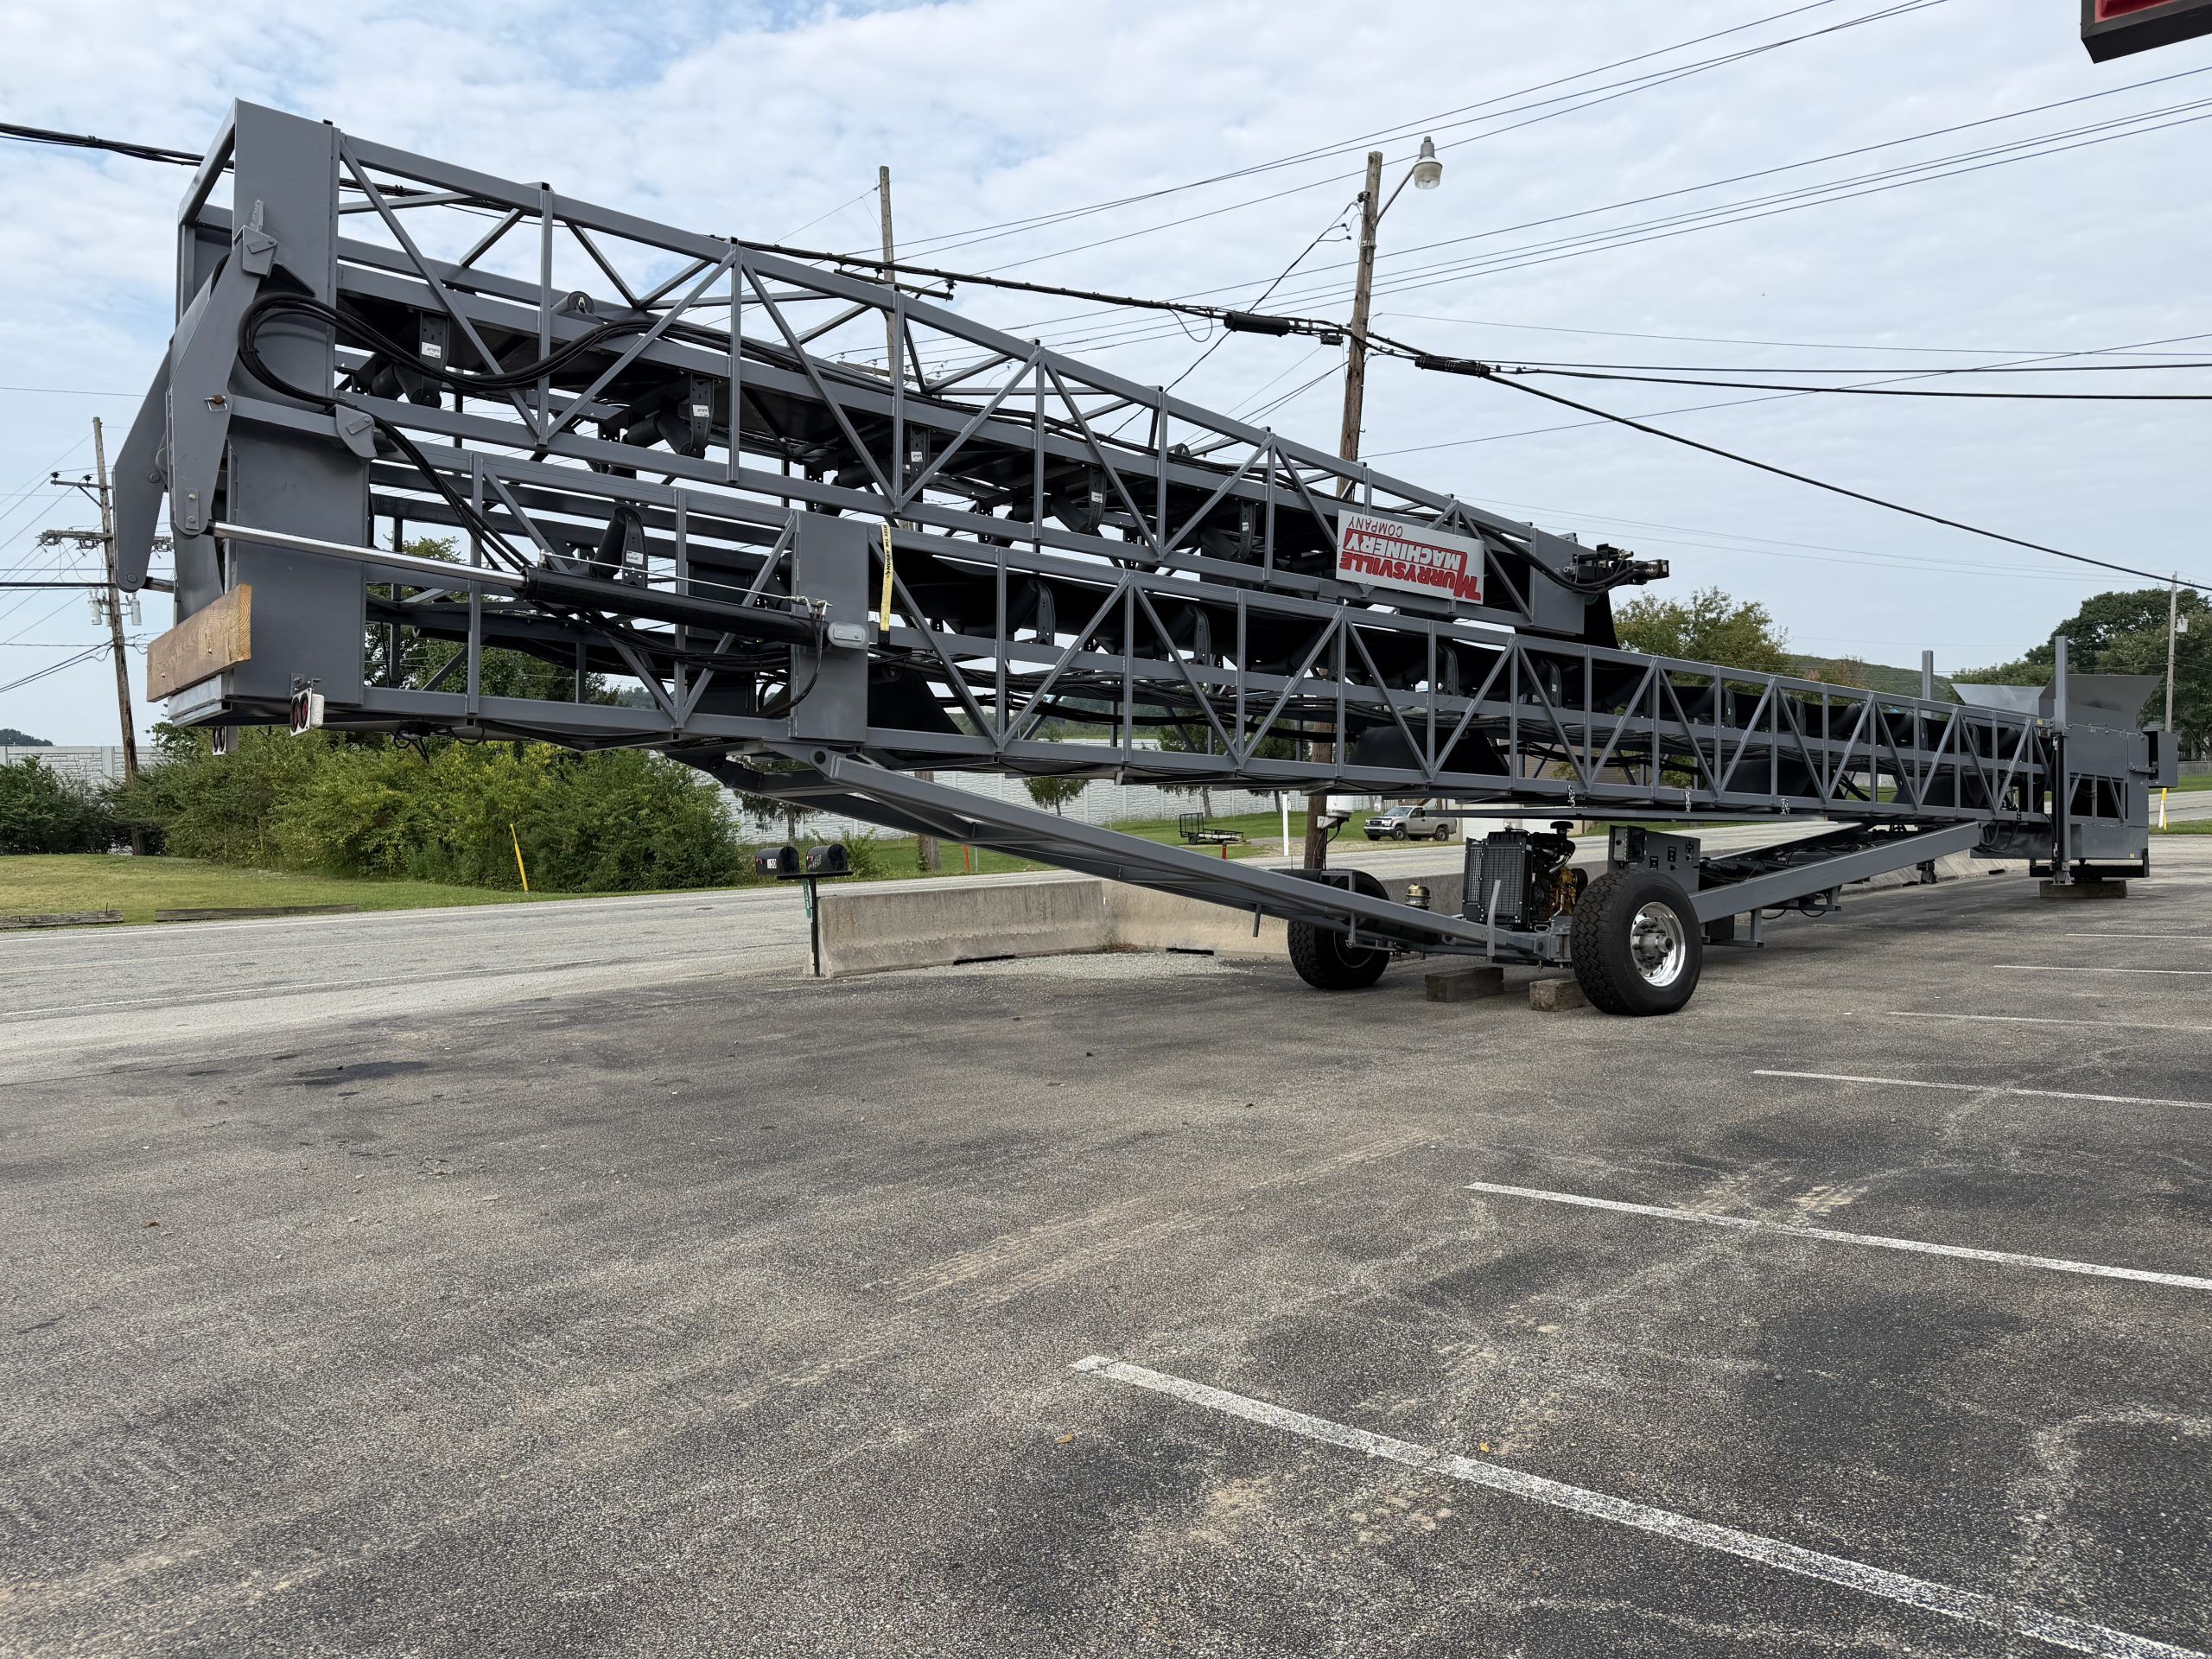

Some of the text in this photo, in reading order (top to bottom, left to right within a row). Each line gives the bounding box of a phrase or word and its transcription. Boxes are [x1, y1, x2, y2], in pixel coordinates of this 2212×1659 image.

[1348, 516, 1403, 537] COMPANY
[1344, 532, 1462, 570] MACHINERY
[1339, 551, 1481, 601] MURRYSVILLE
